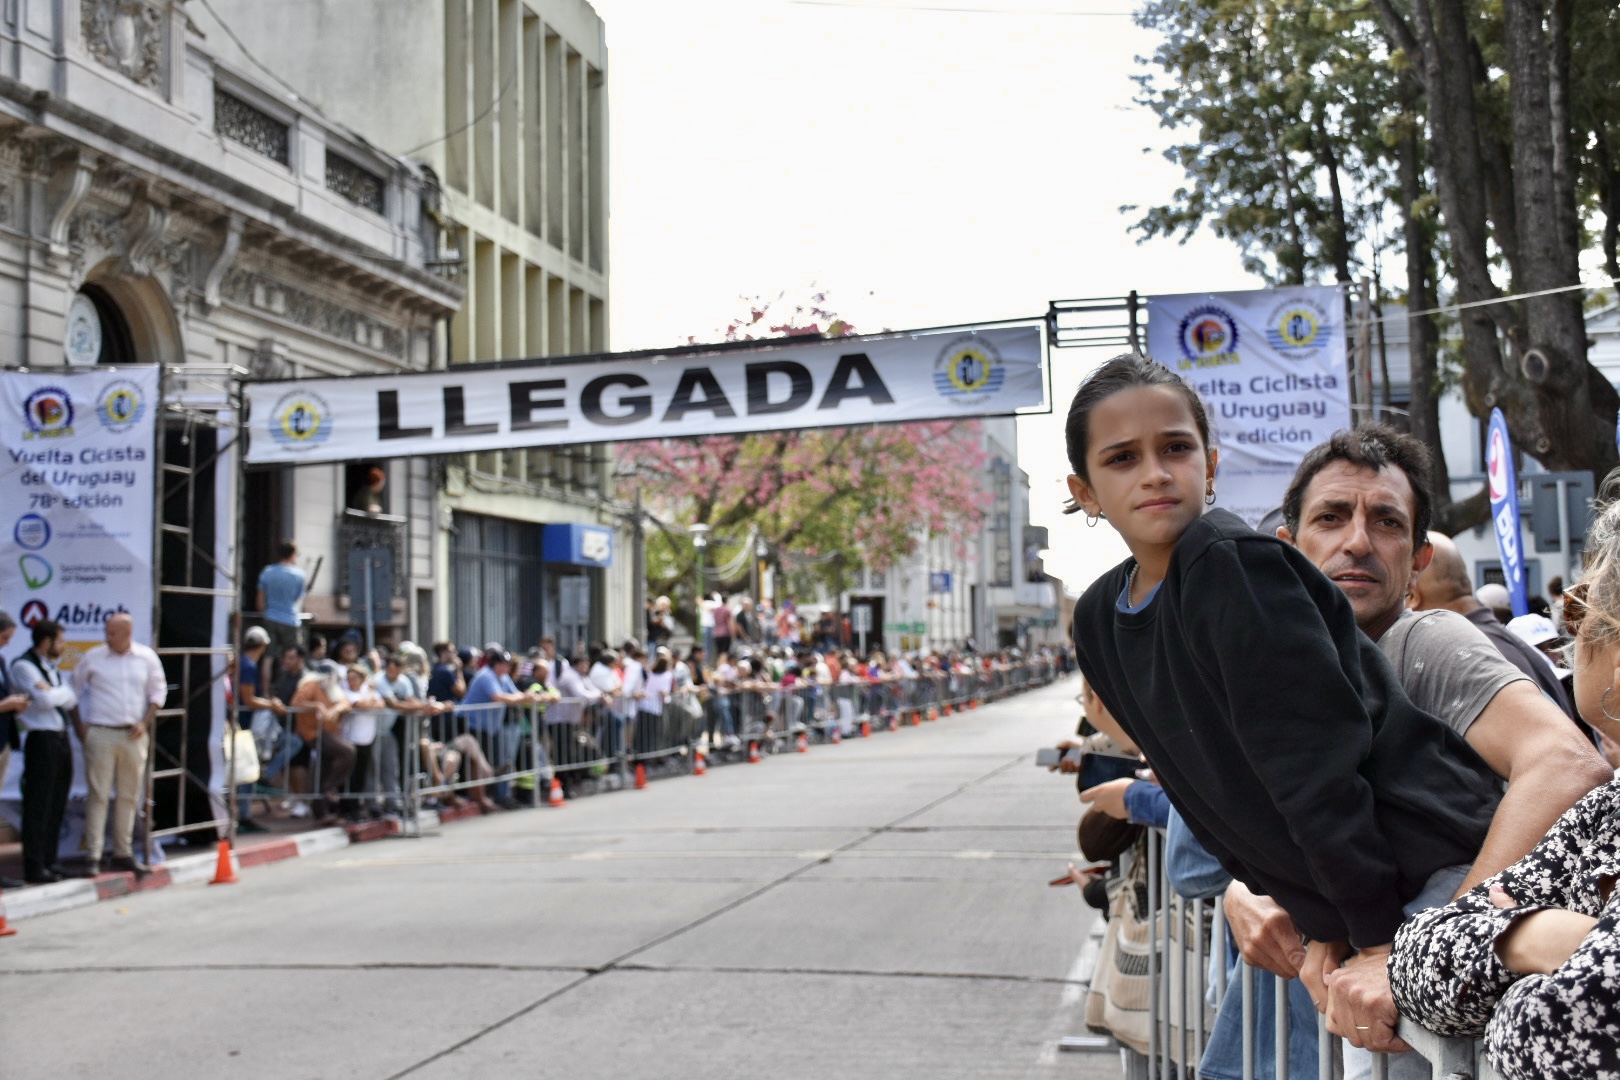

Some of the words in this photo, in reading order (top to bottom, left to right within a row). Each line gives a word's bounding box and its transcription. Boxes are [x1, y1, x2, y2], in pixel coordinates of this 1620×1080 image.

[1250, 373, 1338, 394] Ciclista
[377, 352, 896, 441] LLEGADA
[1221, 401, 1326, 421] Uruguay
[1236, 427, 1312, 444] edición
[8, 448, 74, 464] Vuelta
[80, 445, 146, 464] Ciclista
[20, 470, 46, 485] del
[53, 470, 136, 488] Uruguay
[62, 493, 123, 509] edición
